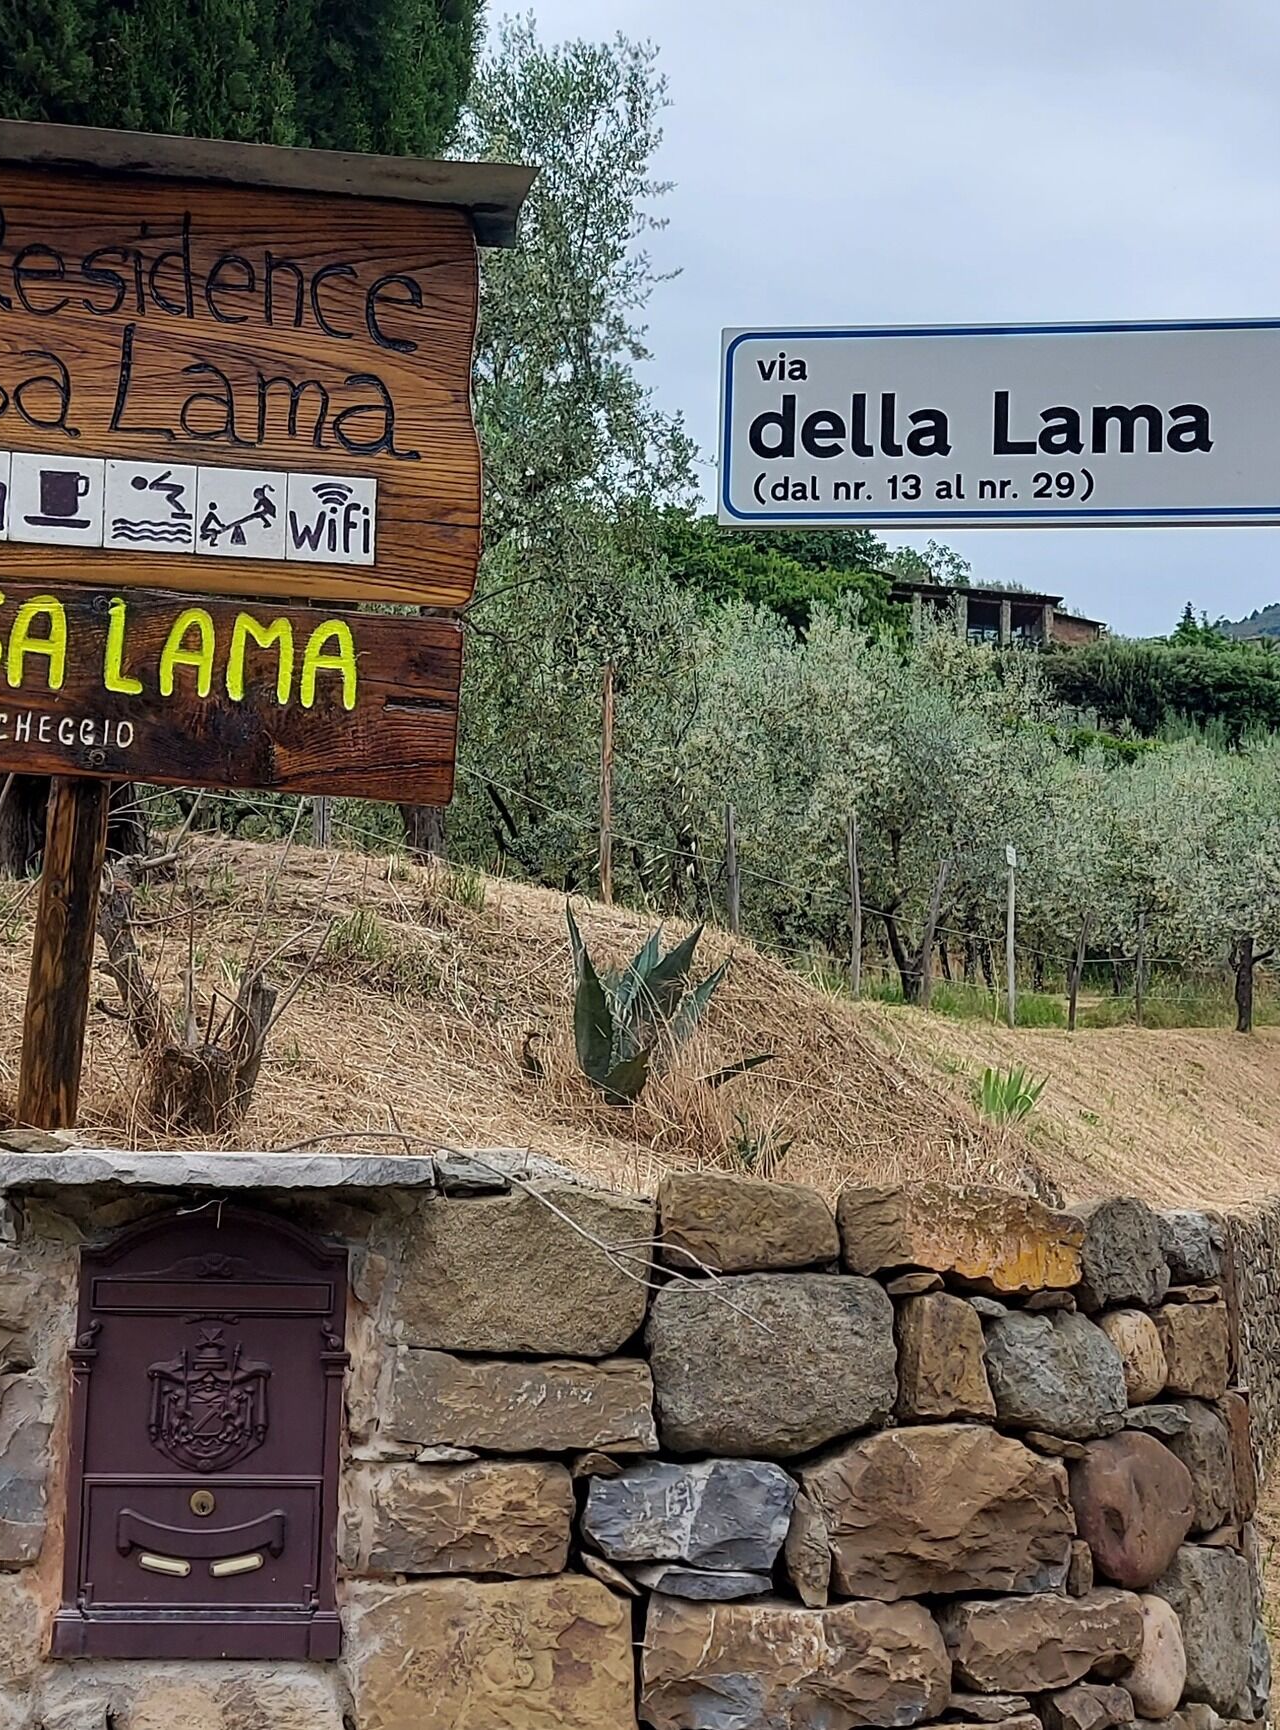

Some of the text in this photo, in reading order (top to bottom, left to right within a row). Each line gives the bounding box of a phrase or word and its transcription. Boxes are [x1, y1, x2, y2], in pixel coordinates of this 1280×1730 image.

[107, 322, 422, 461] Lama
[756, 352, 809, 382] via
[747, 390, 1215, 460] della Lama
[752, 468, 1096, 505] (dal nr. 13 al nr. 29)
[102, 597, 359, 711] LAMA
